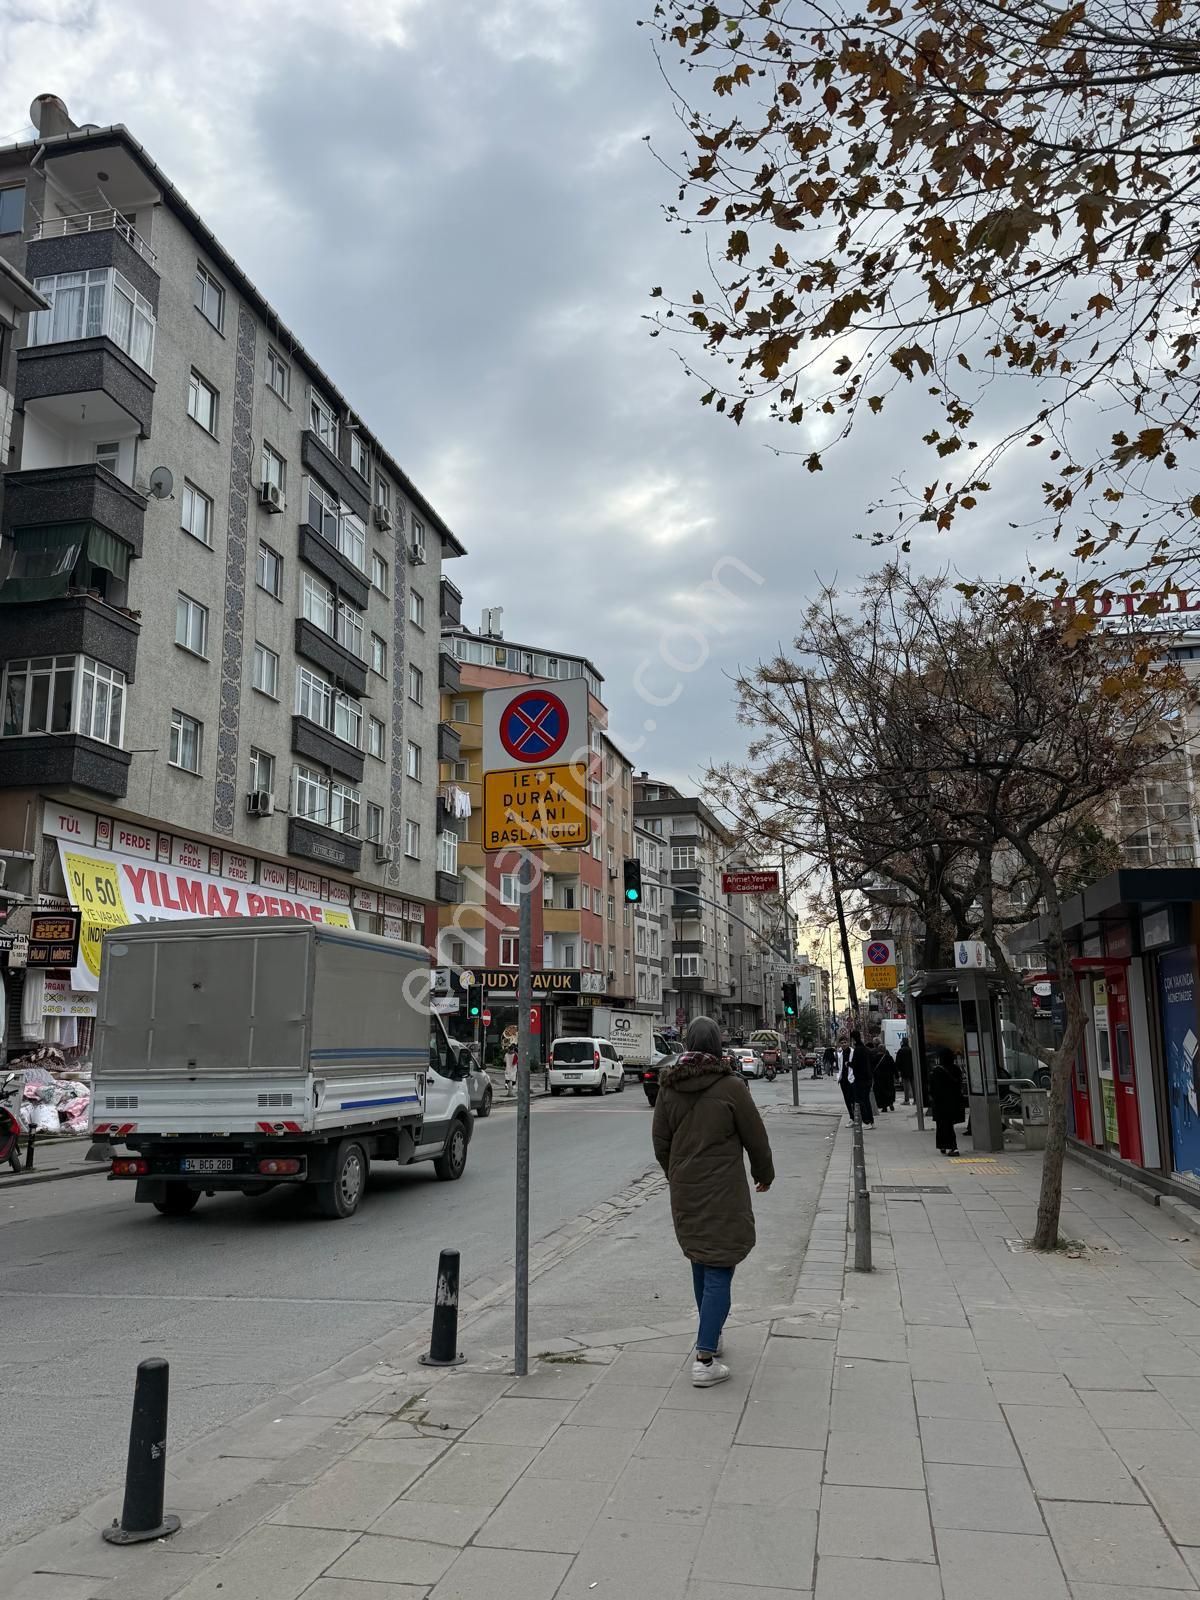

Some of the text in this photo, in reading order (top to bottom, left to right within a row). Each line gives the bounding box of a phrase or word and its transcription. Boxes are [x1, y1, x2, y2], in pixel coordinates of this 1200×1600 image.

[1052, 589, 1200, 618] HOTEL
[513, 772, 555, 787] İETT
[503, 789, 567, 807] DURAK
[506, 807, 565, 824] ALANI
[59, 815, 81, 834] TÜL
[119, 831, 151, 850] PERDE
[183, 843, 199, 855] FON
[179, 855, 201, 869] PERDE
[230, 856, 247, 868] STOR
[228, 867, 248, 880] PERDE
[263, 868, 285, 884] UYGUN
[726, 876, 751, 884] Ahmet
[95, 877, 117, 906] 50
[122, 863, 323, 922] YILMAZ PERDE
[87, 922, 110, 944] İNDİR
[52, 948, 71, 960] MİDYE
[480, 973, 519, 988] JUDY
[530, 974, 572, 988] AVUK
[186, 1159, 196, 1170] 34
